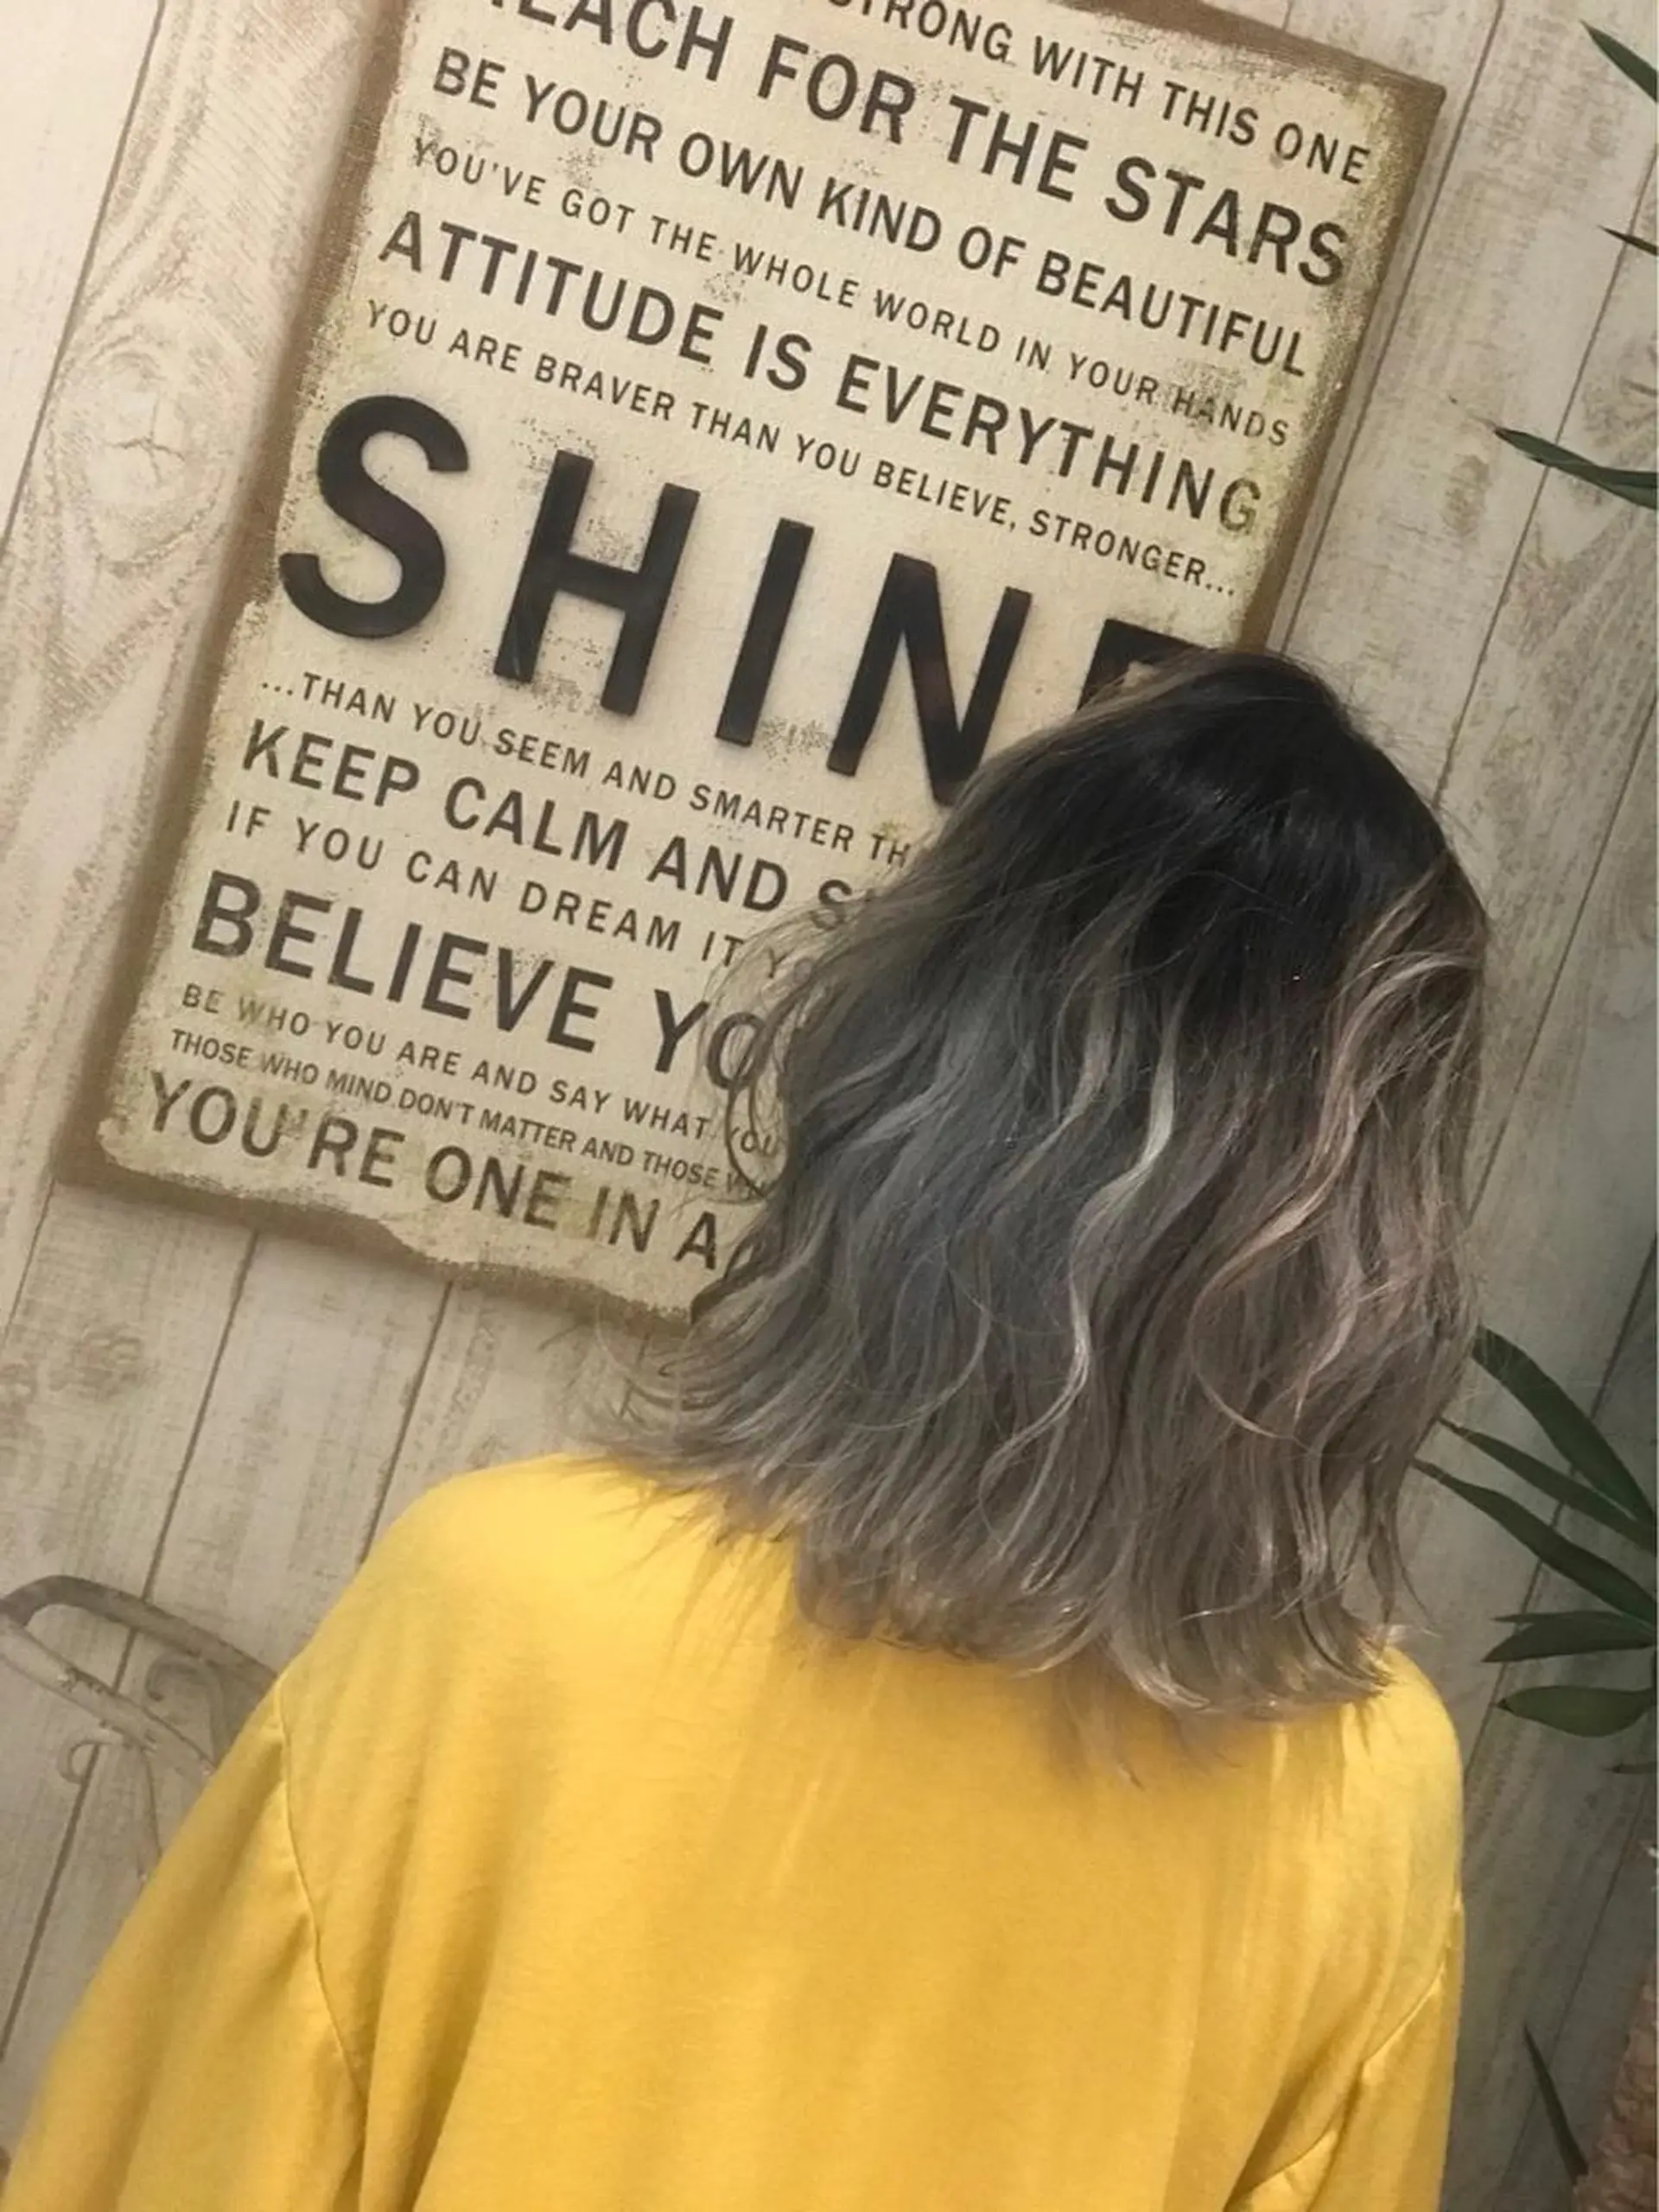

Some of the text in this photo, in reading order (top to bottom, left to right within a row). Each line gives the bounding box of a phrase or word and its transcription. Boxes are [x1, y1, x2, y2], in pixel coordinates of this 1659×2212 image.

[757, 34, 916, 144] FOR
[948, 96, 1089, 202] THE
[1105, 156, 1350, 287] STARS
[829, 0, 1370, 184] RONG WITH THIS ONE
[412, 137, 1289, 448] YOU'VE GOT THE WHOLE WORLD IN YOUR HANDS
[434, 47, 1306, 377] BE YOUR OWN KIND OF BEAUTIFUL
[368, 299, 1237, 596] YOU ARE BRAVER THAN YOU BELIEVE, STRONGER...
[378, 210, 1262, 534] ATTITUDE IS EVERYTHING
[242, 719, 420, 808] KEEP
[443, 777, 630, 871] CALM
[646, 835, 789, 913] AND
[261, 672, 396, 724] ...THAN
[413, 703, 481, 746] YOU
[494, 729, 591, 777] SEEM
[602, 760, 677, 802] AND
[689, 784, 855, 854] SMARTER
[190, 870, 614, 1054] BELIEVE
[226, 800, 270, 839] IF
[294, 817, 384, 870] YOU
[406, 850, 498, 903] CAN
[519, 880, 682, 953] DREAM
[701, 931, 745, 968] IT
[171, 1029, 254, 1069] THOSE
[260, 1052, 319, 1086] WHO
[325, 1069, 391, 1103] MIND
[397, 1087, 475, 1125] DON'T
[480, 1108, 577, 1156] MATTER
[580, 1133, 635, 1166] AND
[643, 1150, 719, 1187] THOSE
[181, 982, 219, 1015] BE
[238, 994, 310, 1037] WHO
[326, 1019, 385, 1056] YOU
[397, 1040, 461, 1076] ARE
[471, 1059, 537, 1096] AND
[550, 1080, 611, 1115] SAY
[624, 1097, 712, 1140] WHAT
[423, 1145, 574, 1230] ONE
[587, 1185, 660, 1254] IN
[673, 1211, 717, 1270] A
